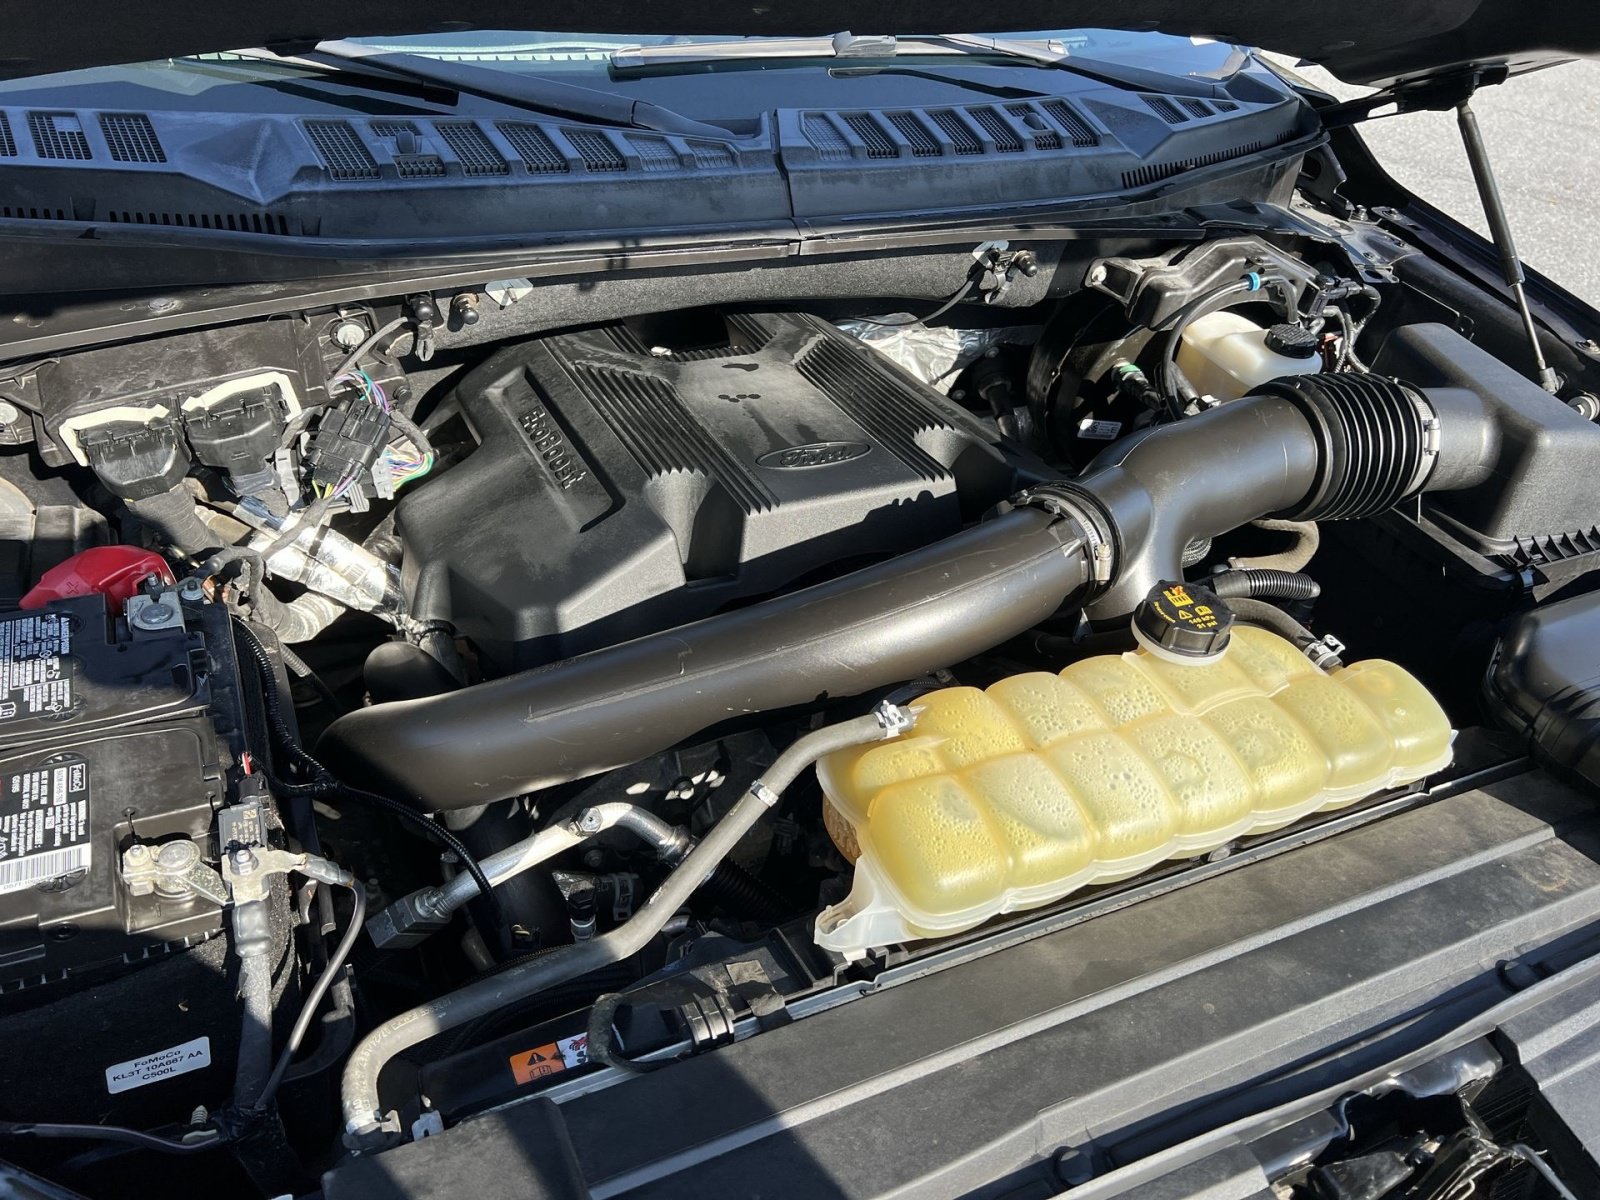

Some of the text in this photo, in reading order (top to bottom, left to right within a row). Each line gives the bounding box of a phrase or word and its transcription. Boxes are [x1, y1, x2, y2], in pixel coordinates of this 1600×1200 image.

[518, 405, 586, 490] EcoBoost
[780, 445, 852, 468] Ford
[72, 765, 82, 791] FoMoCo
[113, 1069, 141, 1081] KL3T
[188, 1050, 203, 1060] AA
[134, 1050, 181, 1068] FoMoCo
[142, 1067, 176, 1080] C500L
